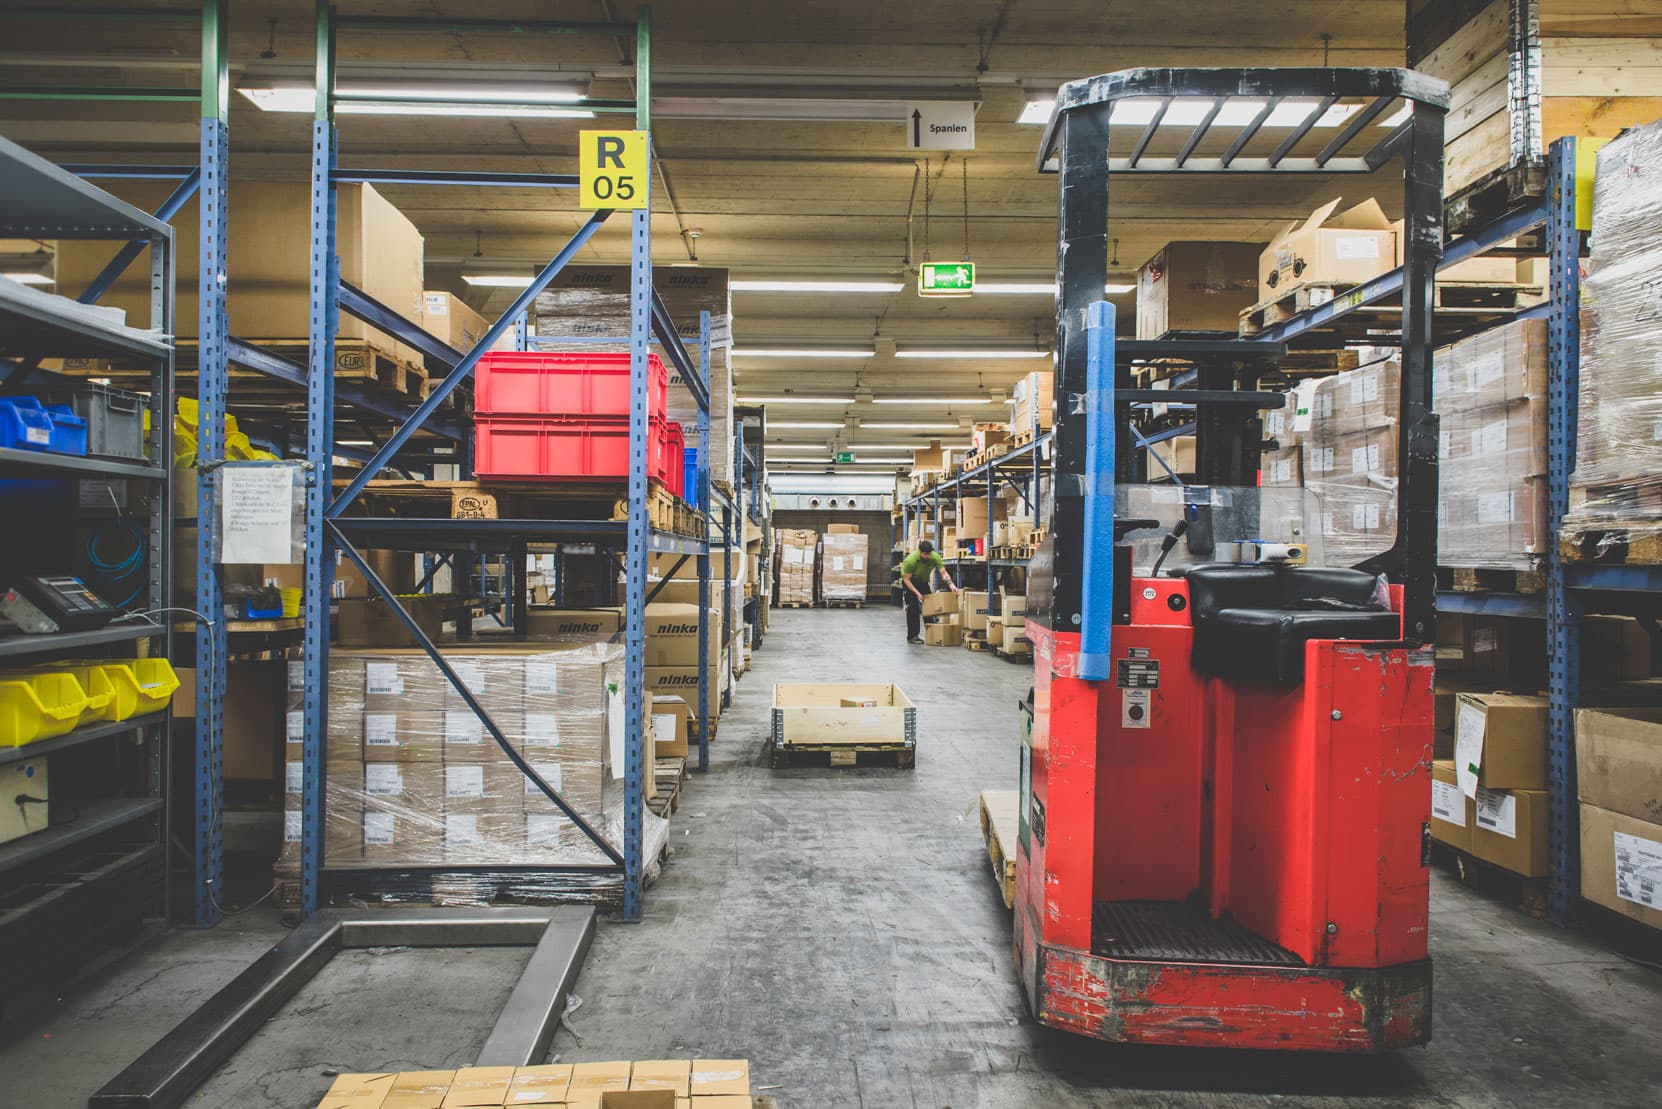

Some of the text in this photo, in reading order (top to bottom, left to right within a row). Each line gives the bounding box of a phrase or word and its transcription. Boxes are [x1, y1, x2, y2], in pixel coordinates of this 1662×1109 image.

[929, 123, 967, 134] Spanien
[597, 136, 626, 169] R
[593, 175, 635, 200] 05
[559, 622, 600, 633] ninka
[657, 623, 698, 634] ninka
[658, 674, 699, 685] ninka
